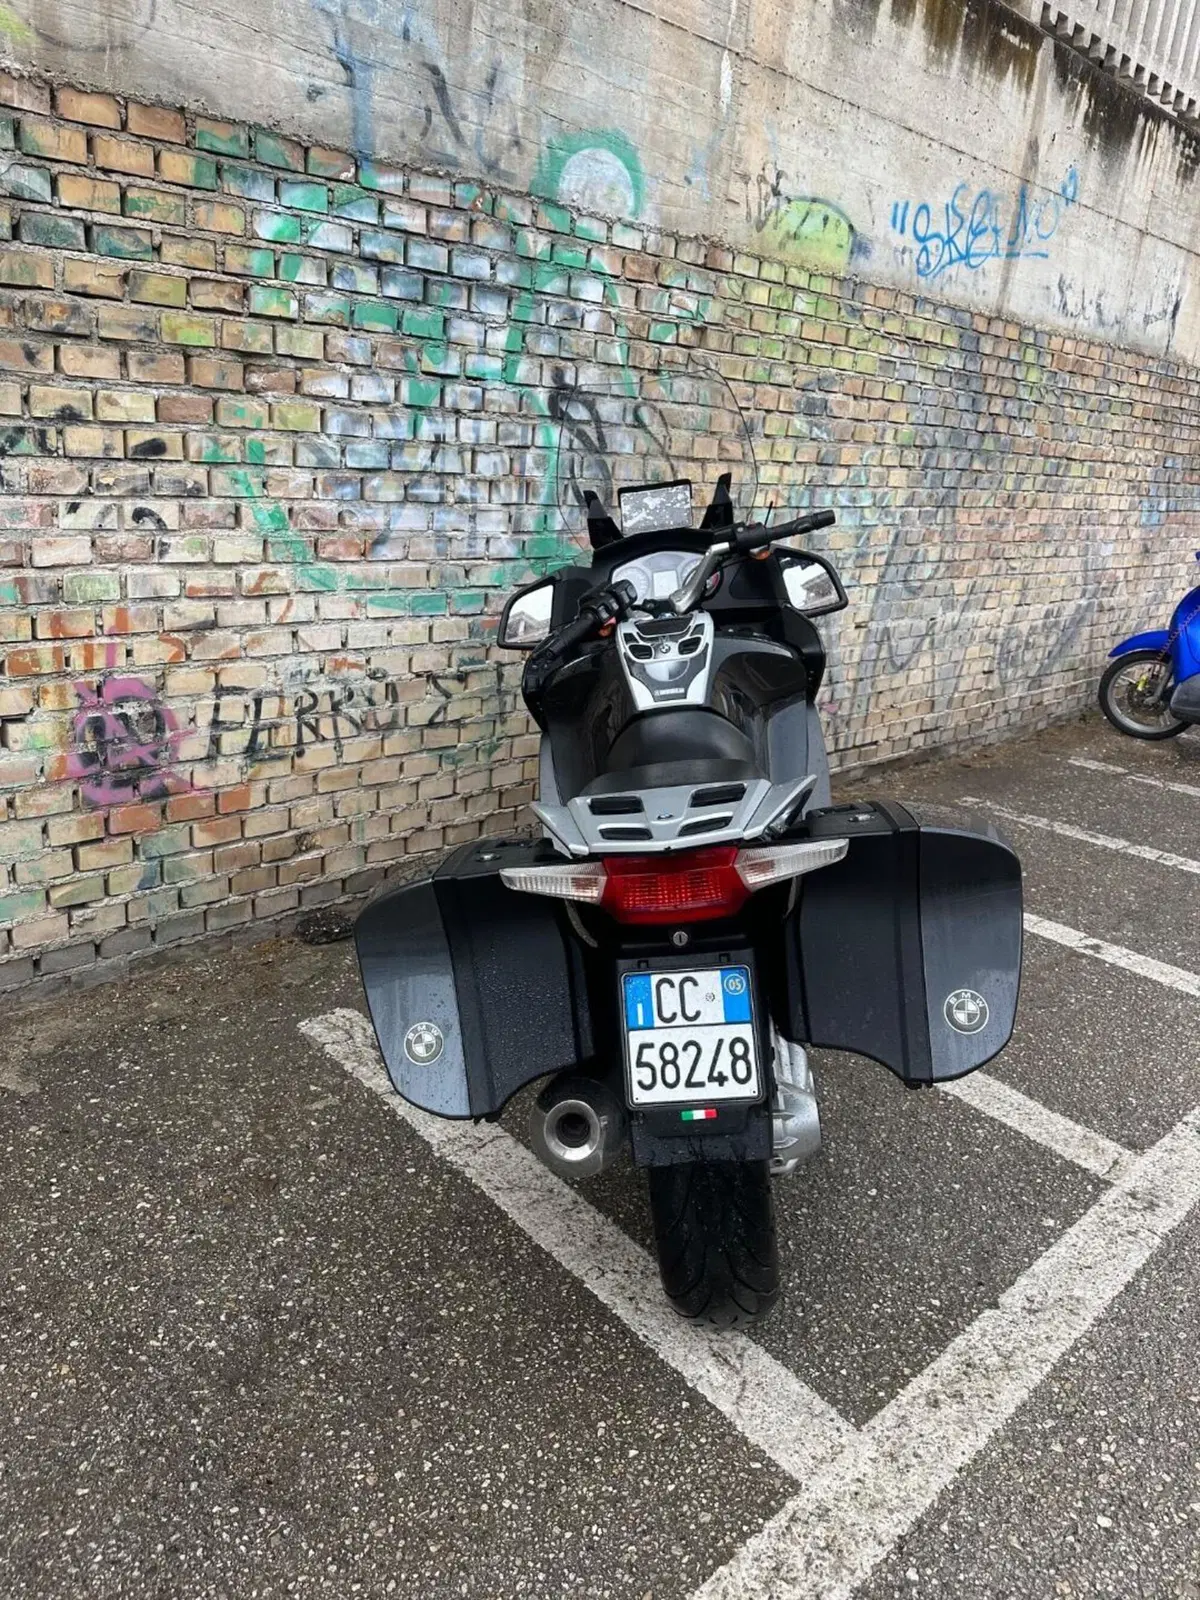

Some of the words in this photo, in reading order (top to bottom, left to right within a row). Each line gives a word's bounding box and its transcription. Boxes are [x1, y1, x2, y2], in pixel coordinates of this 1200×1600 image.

[655, 976, 701, 1023] CC
[728, 977, 742, 991] 05
[636, 1037, 752, 1091] 58248
